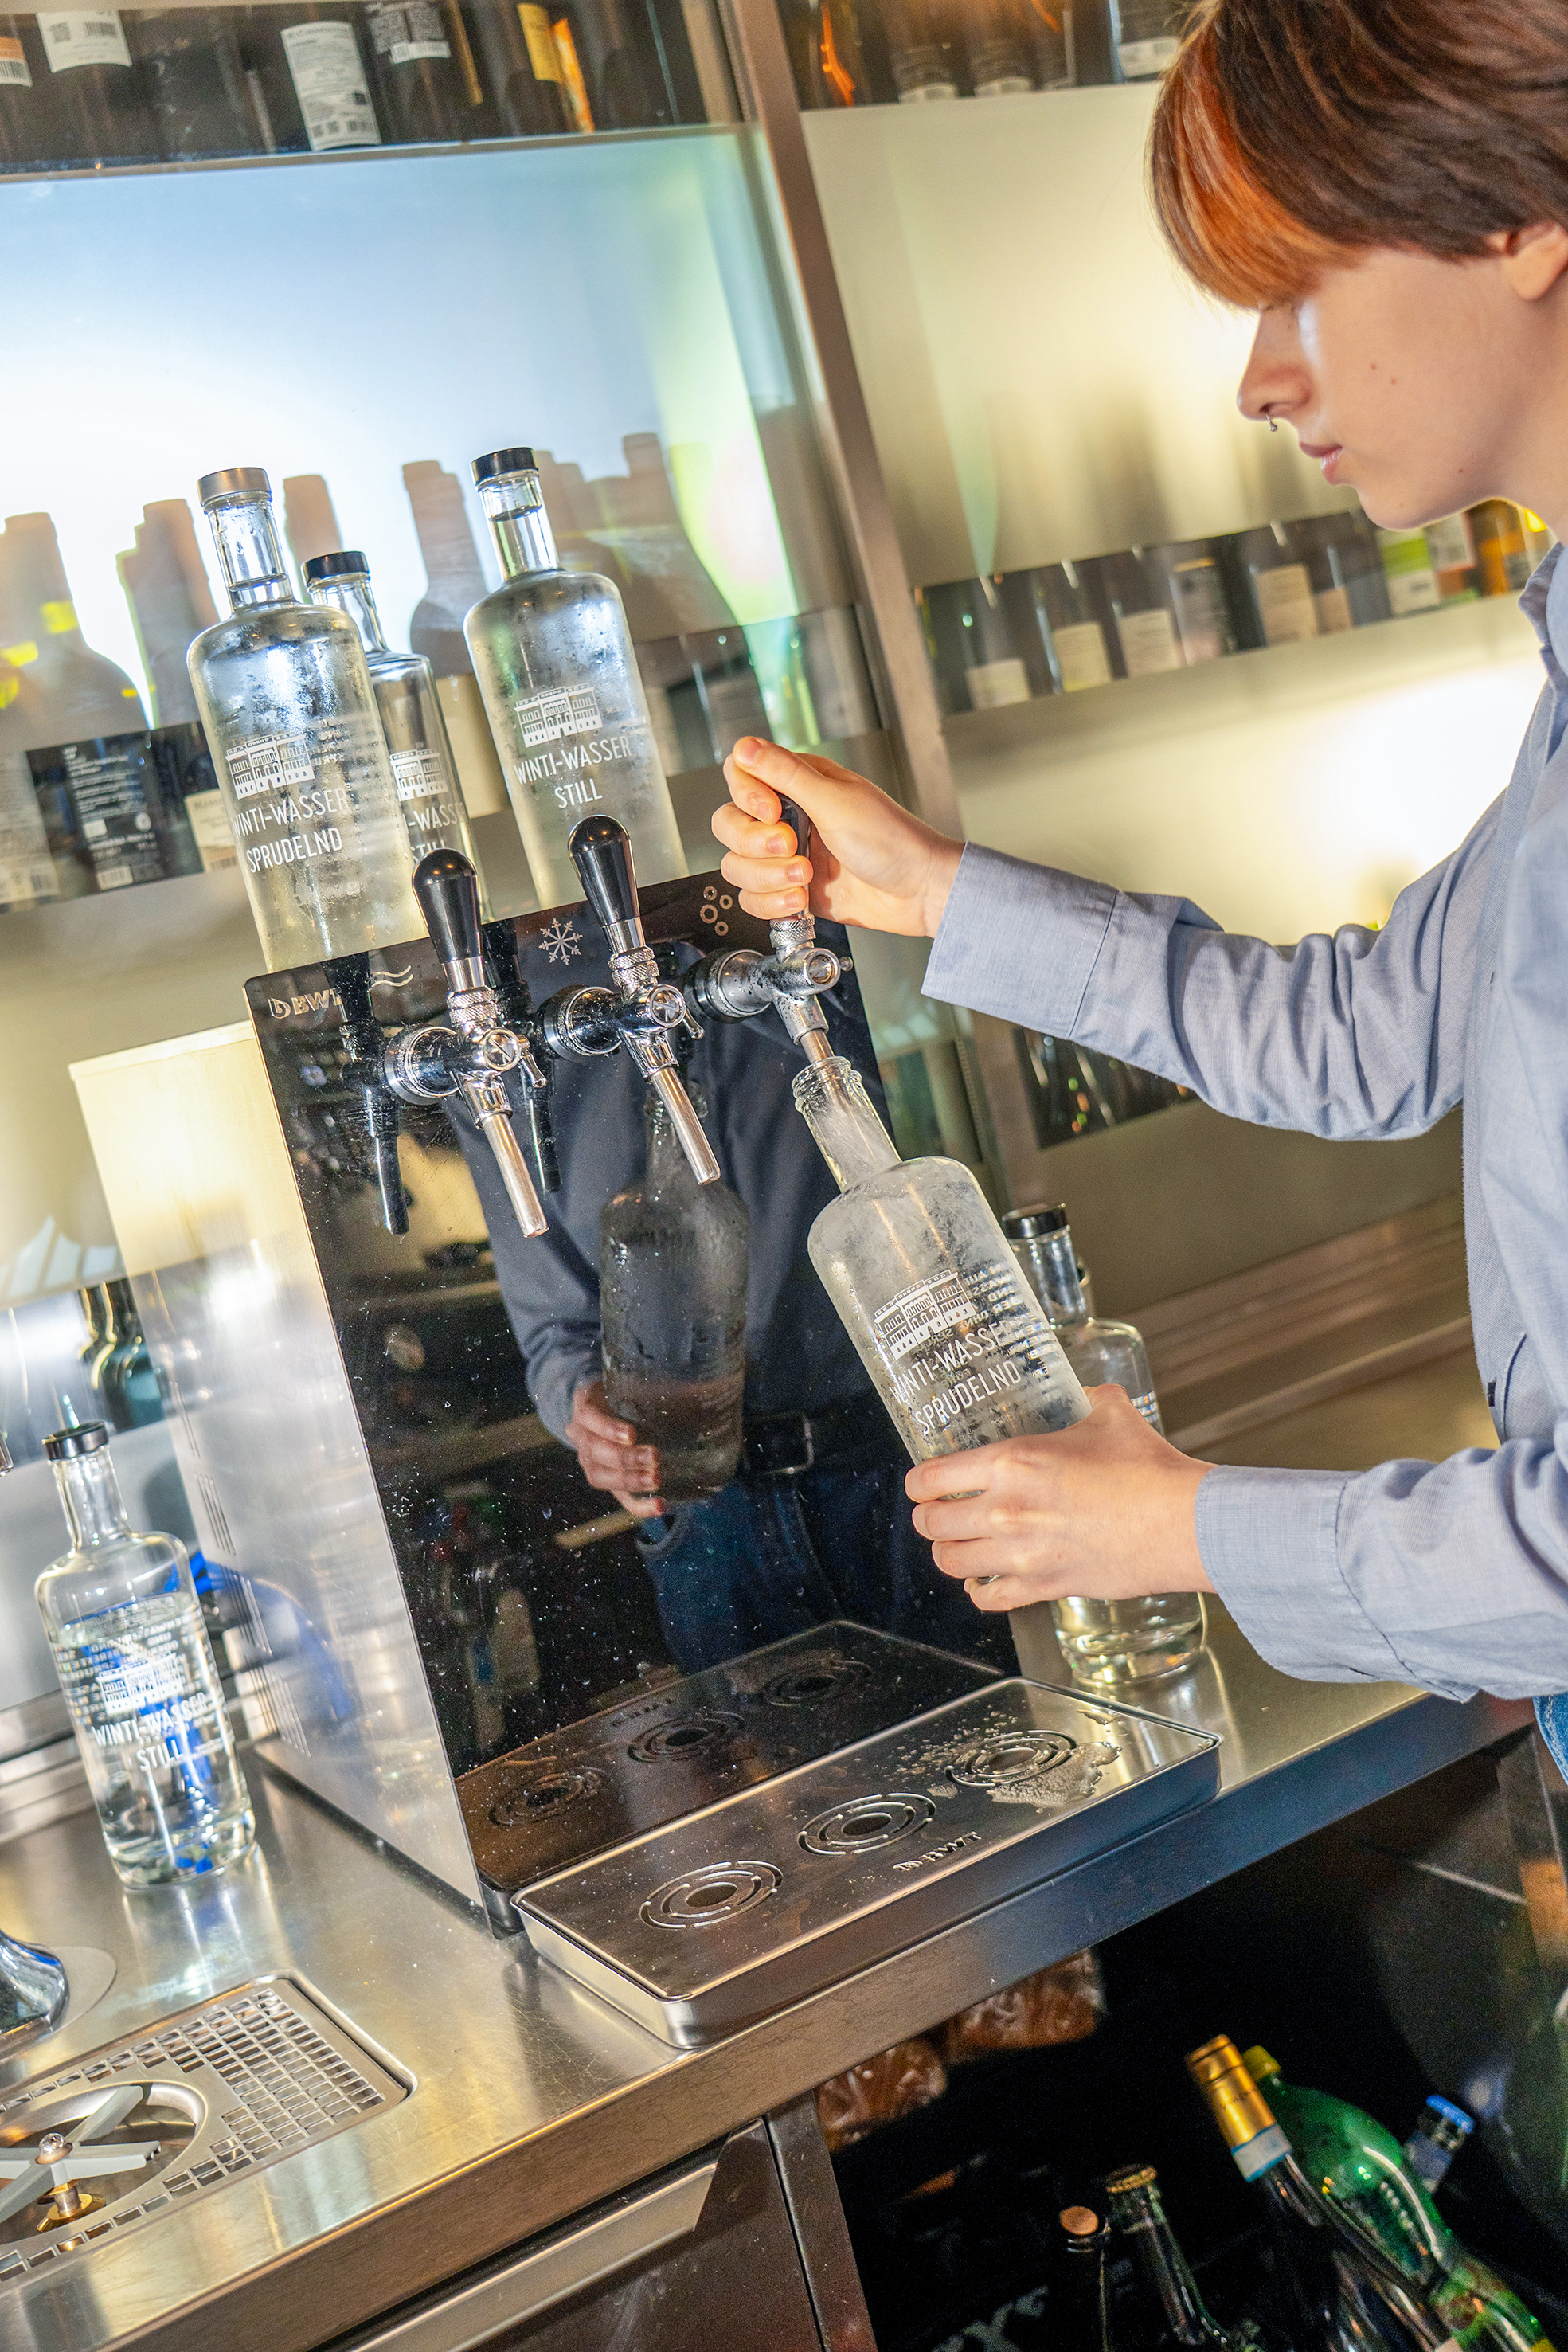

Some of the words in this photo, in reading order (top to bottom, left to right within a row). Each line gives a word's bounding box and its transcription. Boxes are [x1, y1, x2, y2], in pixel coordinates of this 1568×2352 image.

[514, 735, 632, 785] WINTI-WASSER
[233, 786, 351, 840] WINTI-WASSER
[554, 778, 604, 809] STILL
[246, 827, 344, 875] SPRUDELND
[888, 1318, 1021, 1407] WINTI-WASSER
[915, 1360, 1023, 1435] SPRUDELND
[92, 1692, 208, 1747] WINTI-WASSER
[135, 1739, 183, 1772] STILL
